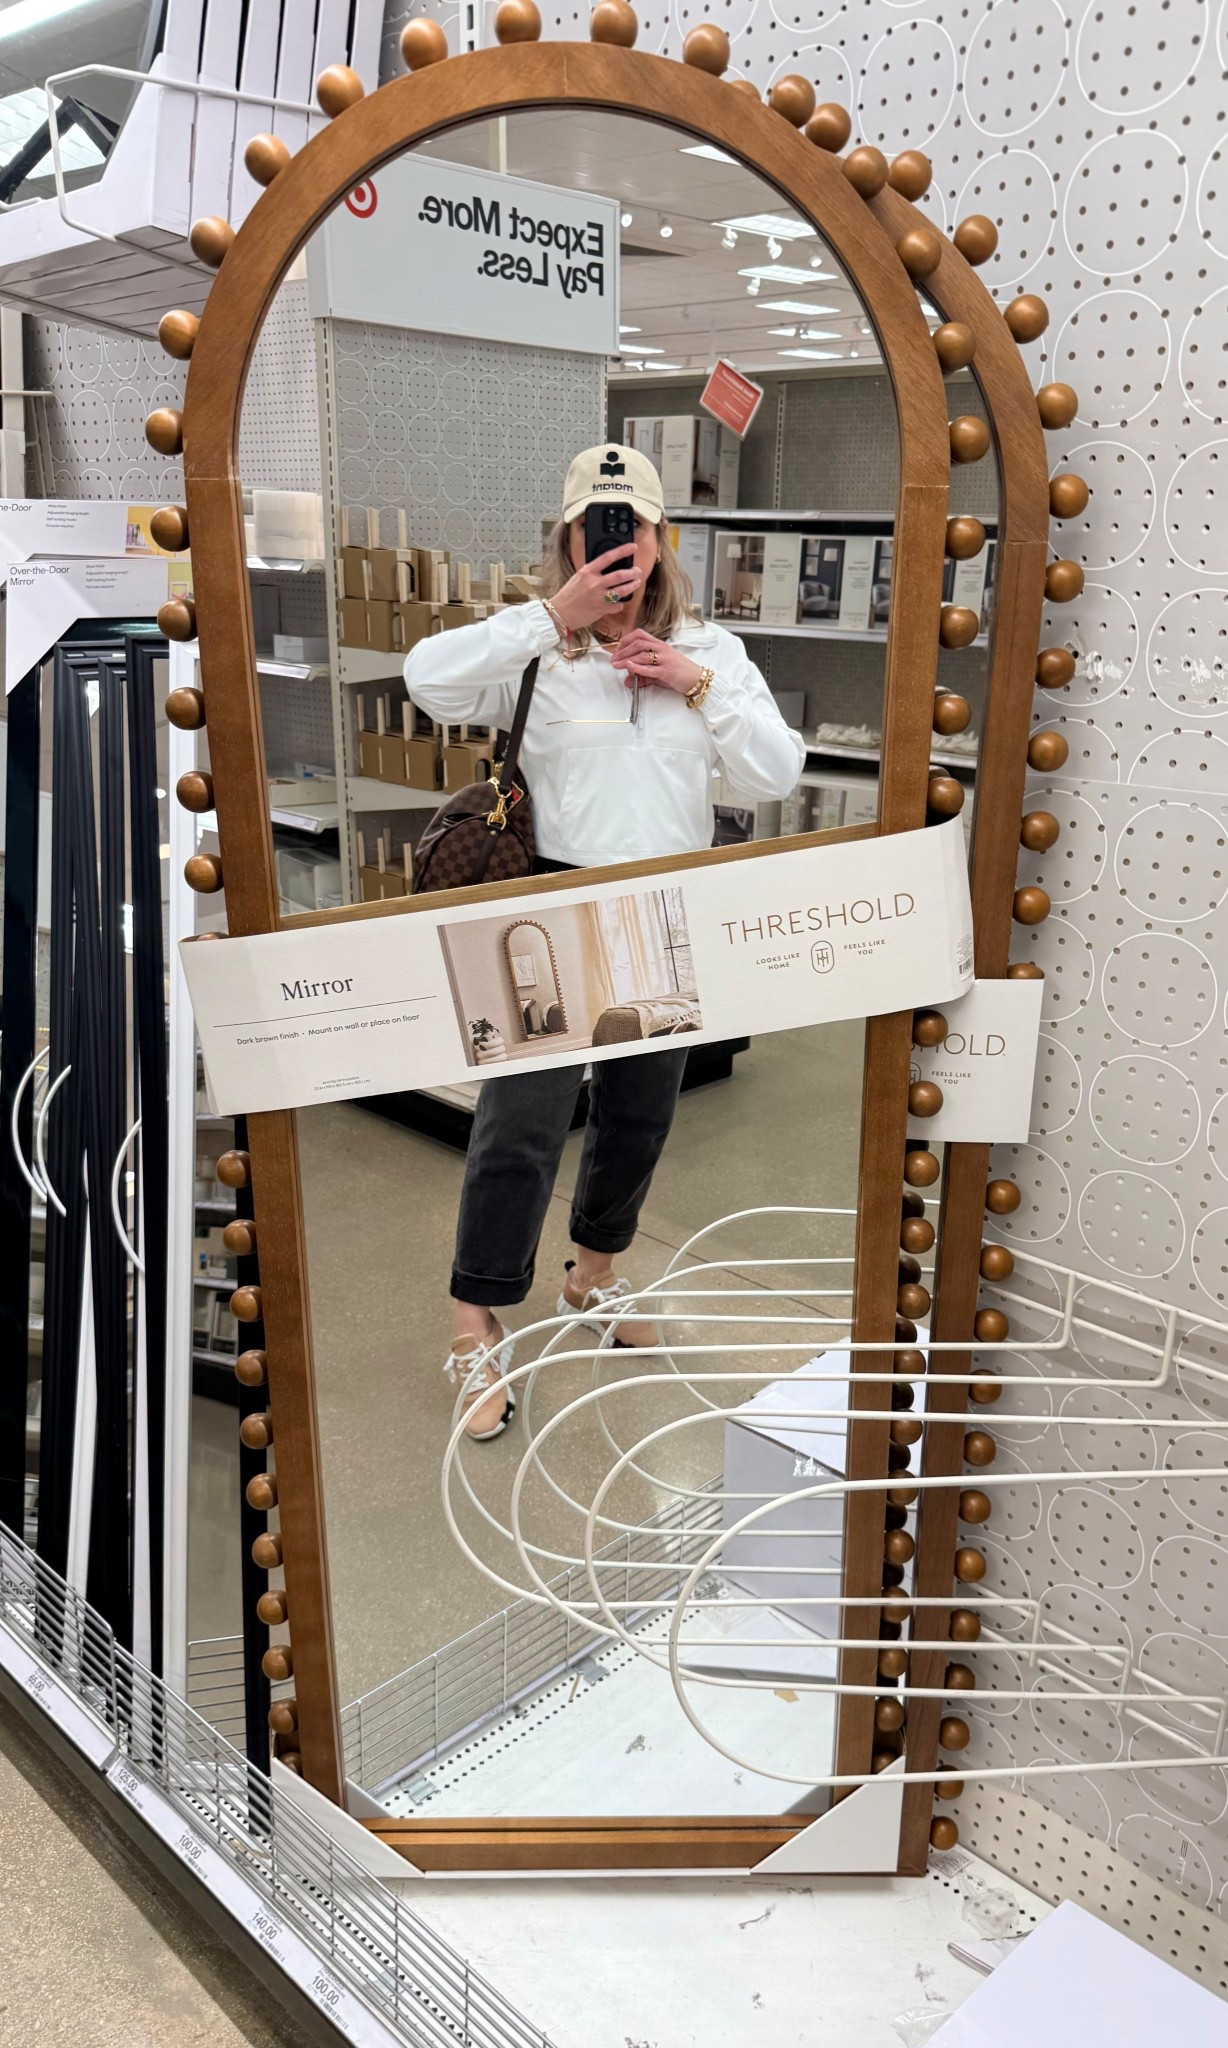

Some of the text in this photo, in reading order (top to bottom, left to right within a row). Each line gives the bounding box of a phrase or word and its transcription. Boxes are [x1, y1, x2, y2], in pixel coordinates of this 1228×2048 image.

[10, 565, 70, 576] Over-the-Door
[10, 577, 35, 586] Mirror
[721, 893, 915, 945] THRESHOLD
[844, 939, 886, 950] FEELS LIKE
[857, 948, 873, 956] YOU
[756, 952, 801, 965] LOOKS LIKE
[768, 962, 790, 970] HOME
[280, 977, 354, 1001] Mirror
[236, 1037, 254, 1045] Dark
[254, 1035, 279, 1043] brown
[279, 1032, 300, 1040] finish
[308, 1027, 332, 1036] Mount
[344, 1022, 360, 1030] wall
[370, 1018, 391, 1028] place
[402, 1014, 420, 1022] floor
[117, 1768, 139, 1791] 125.00
[179, 1834, 202, 1860] 100.00
[252, 1912, 278, 1940] 140.00
[312, 1975, 340, 2006] 100.00
